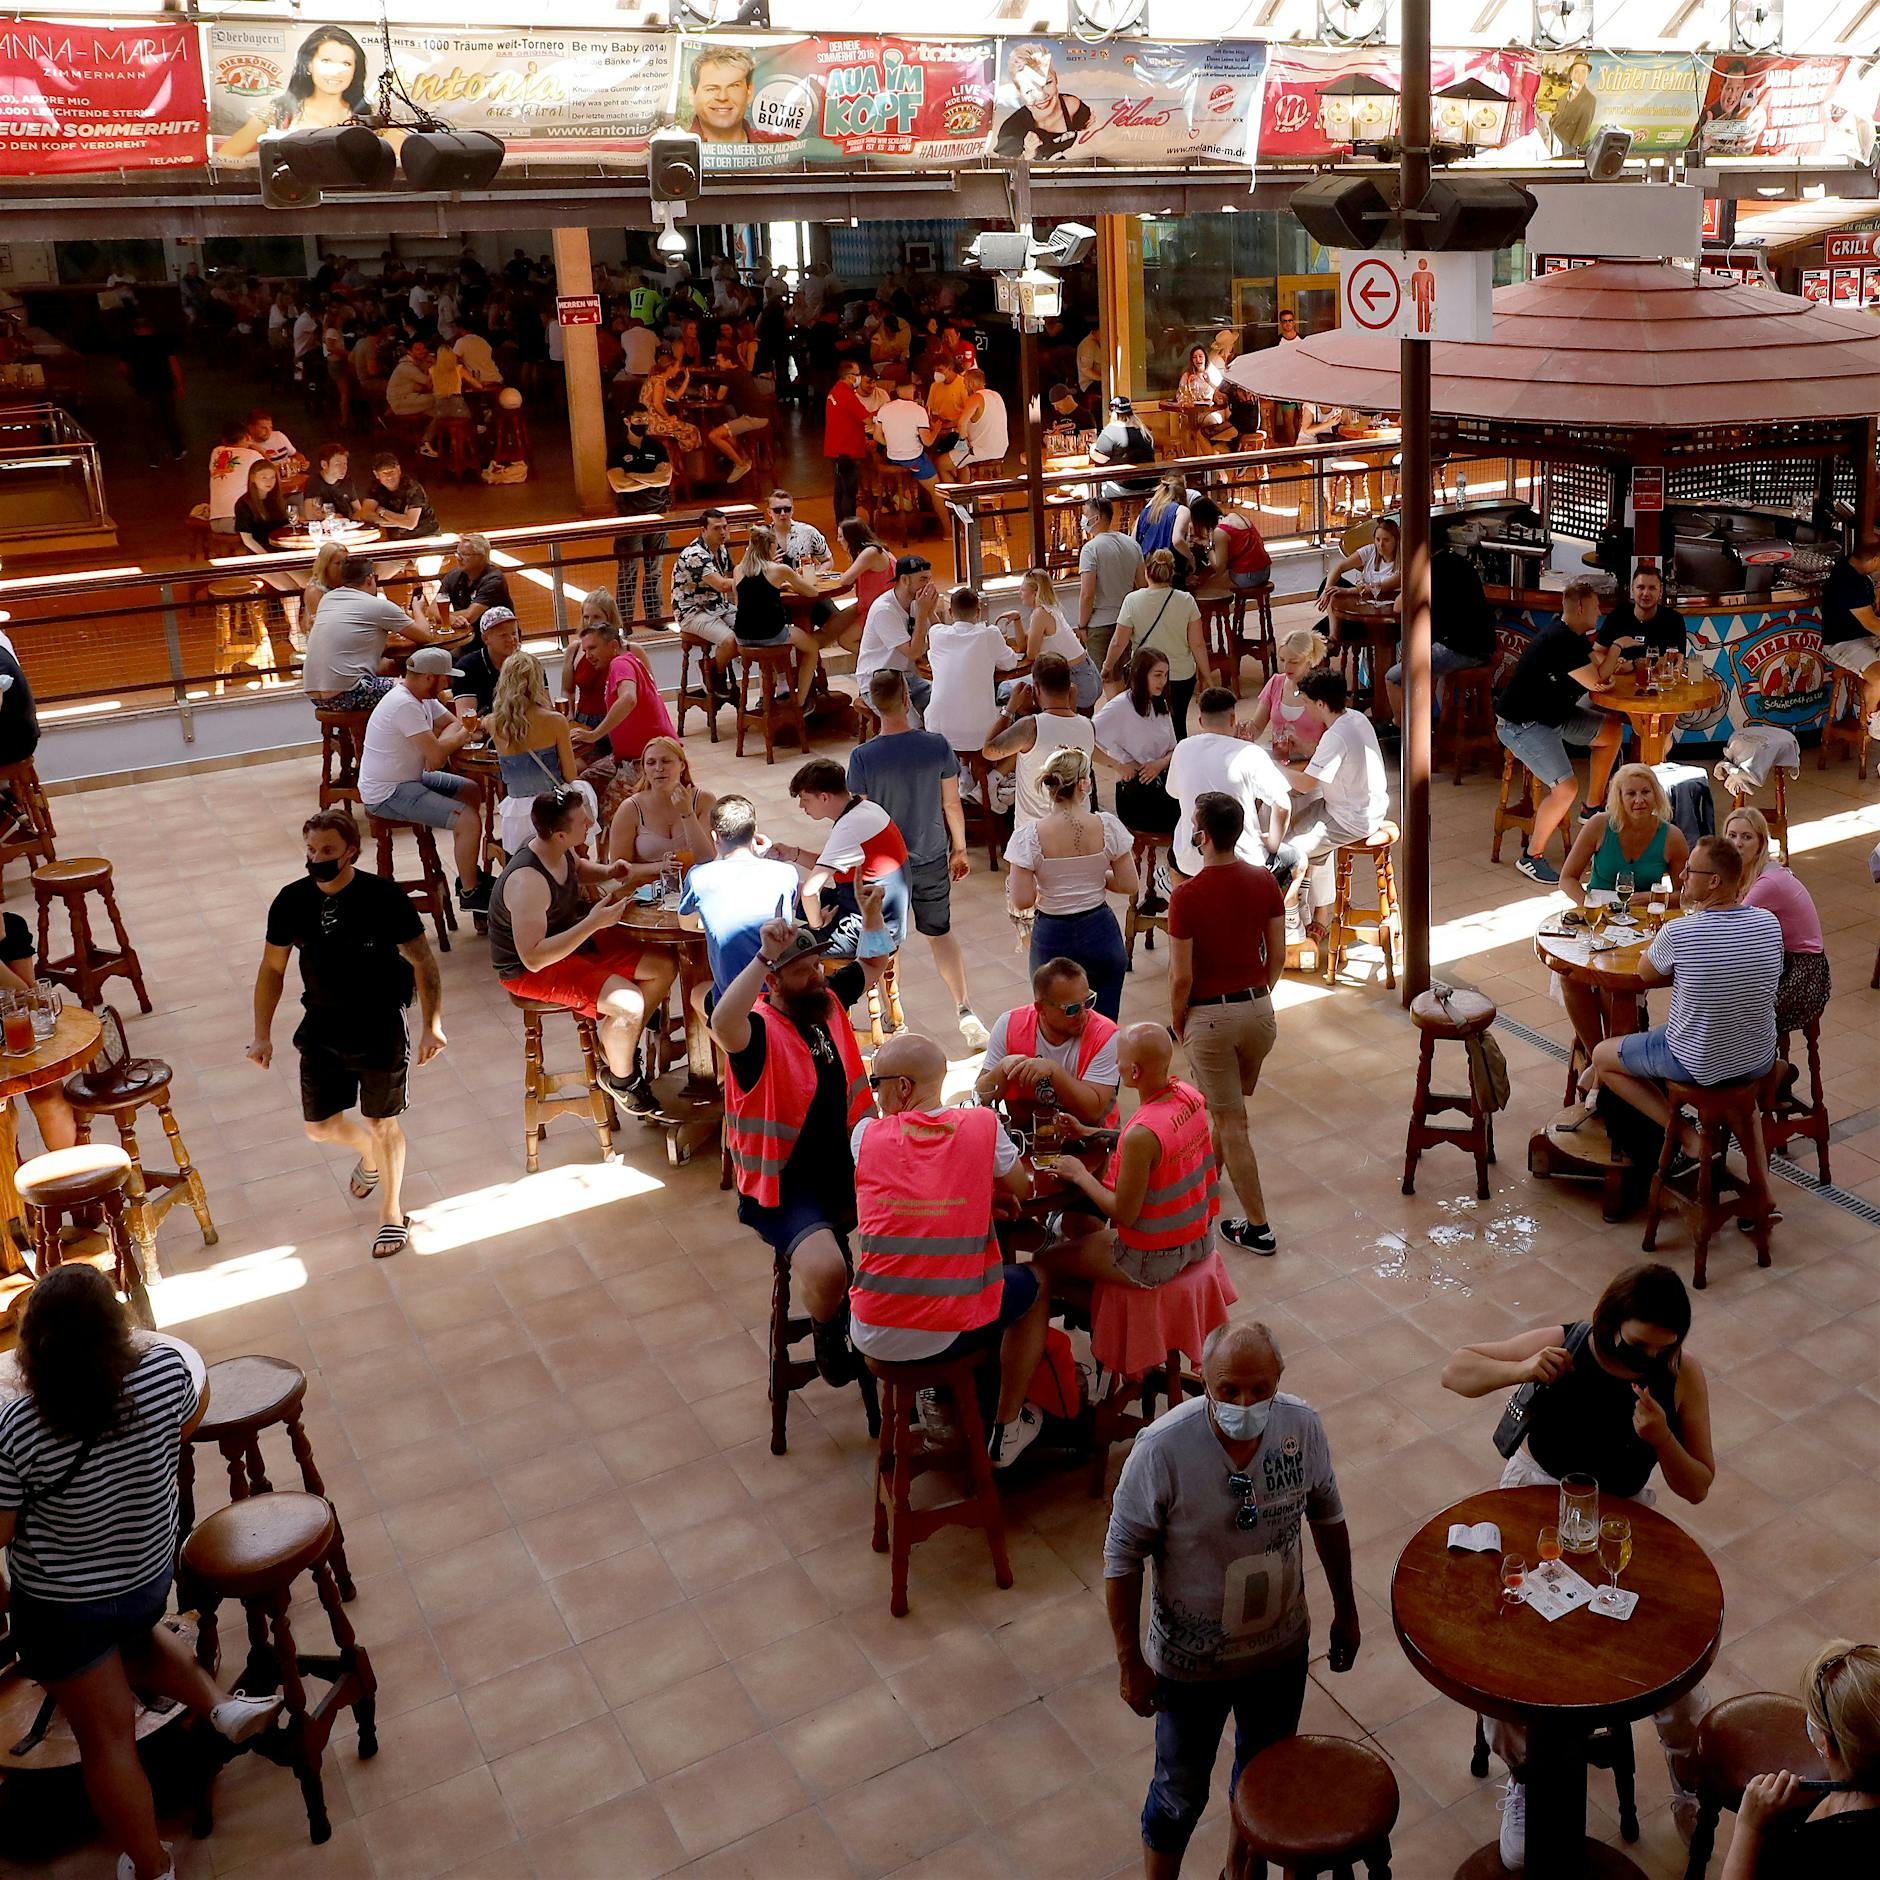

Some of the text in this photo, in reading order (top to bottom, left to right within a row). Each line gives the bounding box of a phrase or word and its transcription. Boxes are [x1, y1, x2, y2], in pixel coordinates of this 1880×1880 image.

[217, 31, 280, 46] Oberbayern
[424, 40, 450, 51] 1000
[454, 40, 494, 51] Träume
[497, 38, 565, 51] weit-Tornero
[829, 40, 861, 52] DER NEUE
[572, 41, 667, 54] Be my Baby (2014)
[817, 49, 874, 64] SOMMERHIT 2016
[218, 57, 280, 73] BIERKÖNIG
[43, 67, 146, 80] ZIMMERMANN
[825, 64, 880, 98] AUA
[1598, 65, 1650, 91] Schäfer
[951, 84, 982, 97] LIVE
[22, 96, 65, 105] AMORE
[68, 97, 90, 106] MIO
[945, 97, 961, 107] JEDE
[33, 108, 110, 118] LEUCHTENDE
[113, 109, 156, 118] STERNE
[606, 111, 628, 119] macht
[760, 100, 805, 118] LOTUS
[823, 90, 924, 137] KOPF
[758, 112, 802, 130] BLUME
[63, 120, 200, 138] SOMMERHIT:
[10, 142, 38, 150] DEN
[42, 142, 76, 151] KOPF
[80, 140, 147, 150] VERDREHT
[702, 144, 717, 155] WIE
[717, 144, 732, 155] DAS
[757, 140, 808, 154] SCHLAUCHBOOT
[919, 140, 986, 159] #AUAIMKOPF
[1166, 143, 1247, 158] www.melanie-m.de
[148, 155, 194, 166] TELAMO
[703, 158, 716, 168] IST
[717, 157, 732, 168] DER
[732, 156, 759, 167] TEUFEL
[1832, 240, 1869, 256] GRILL
[635, 292, 645, 306] 11
[975, 335, 989, 351] 27
[1744, 632, 1824, 670] BIERKÖN
[1262, 1450, 1303, 1475] CAMP
[1265, 1468, 1304, 1492] DAVID
